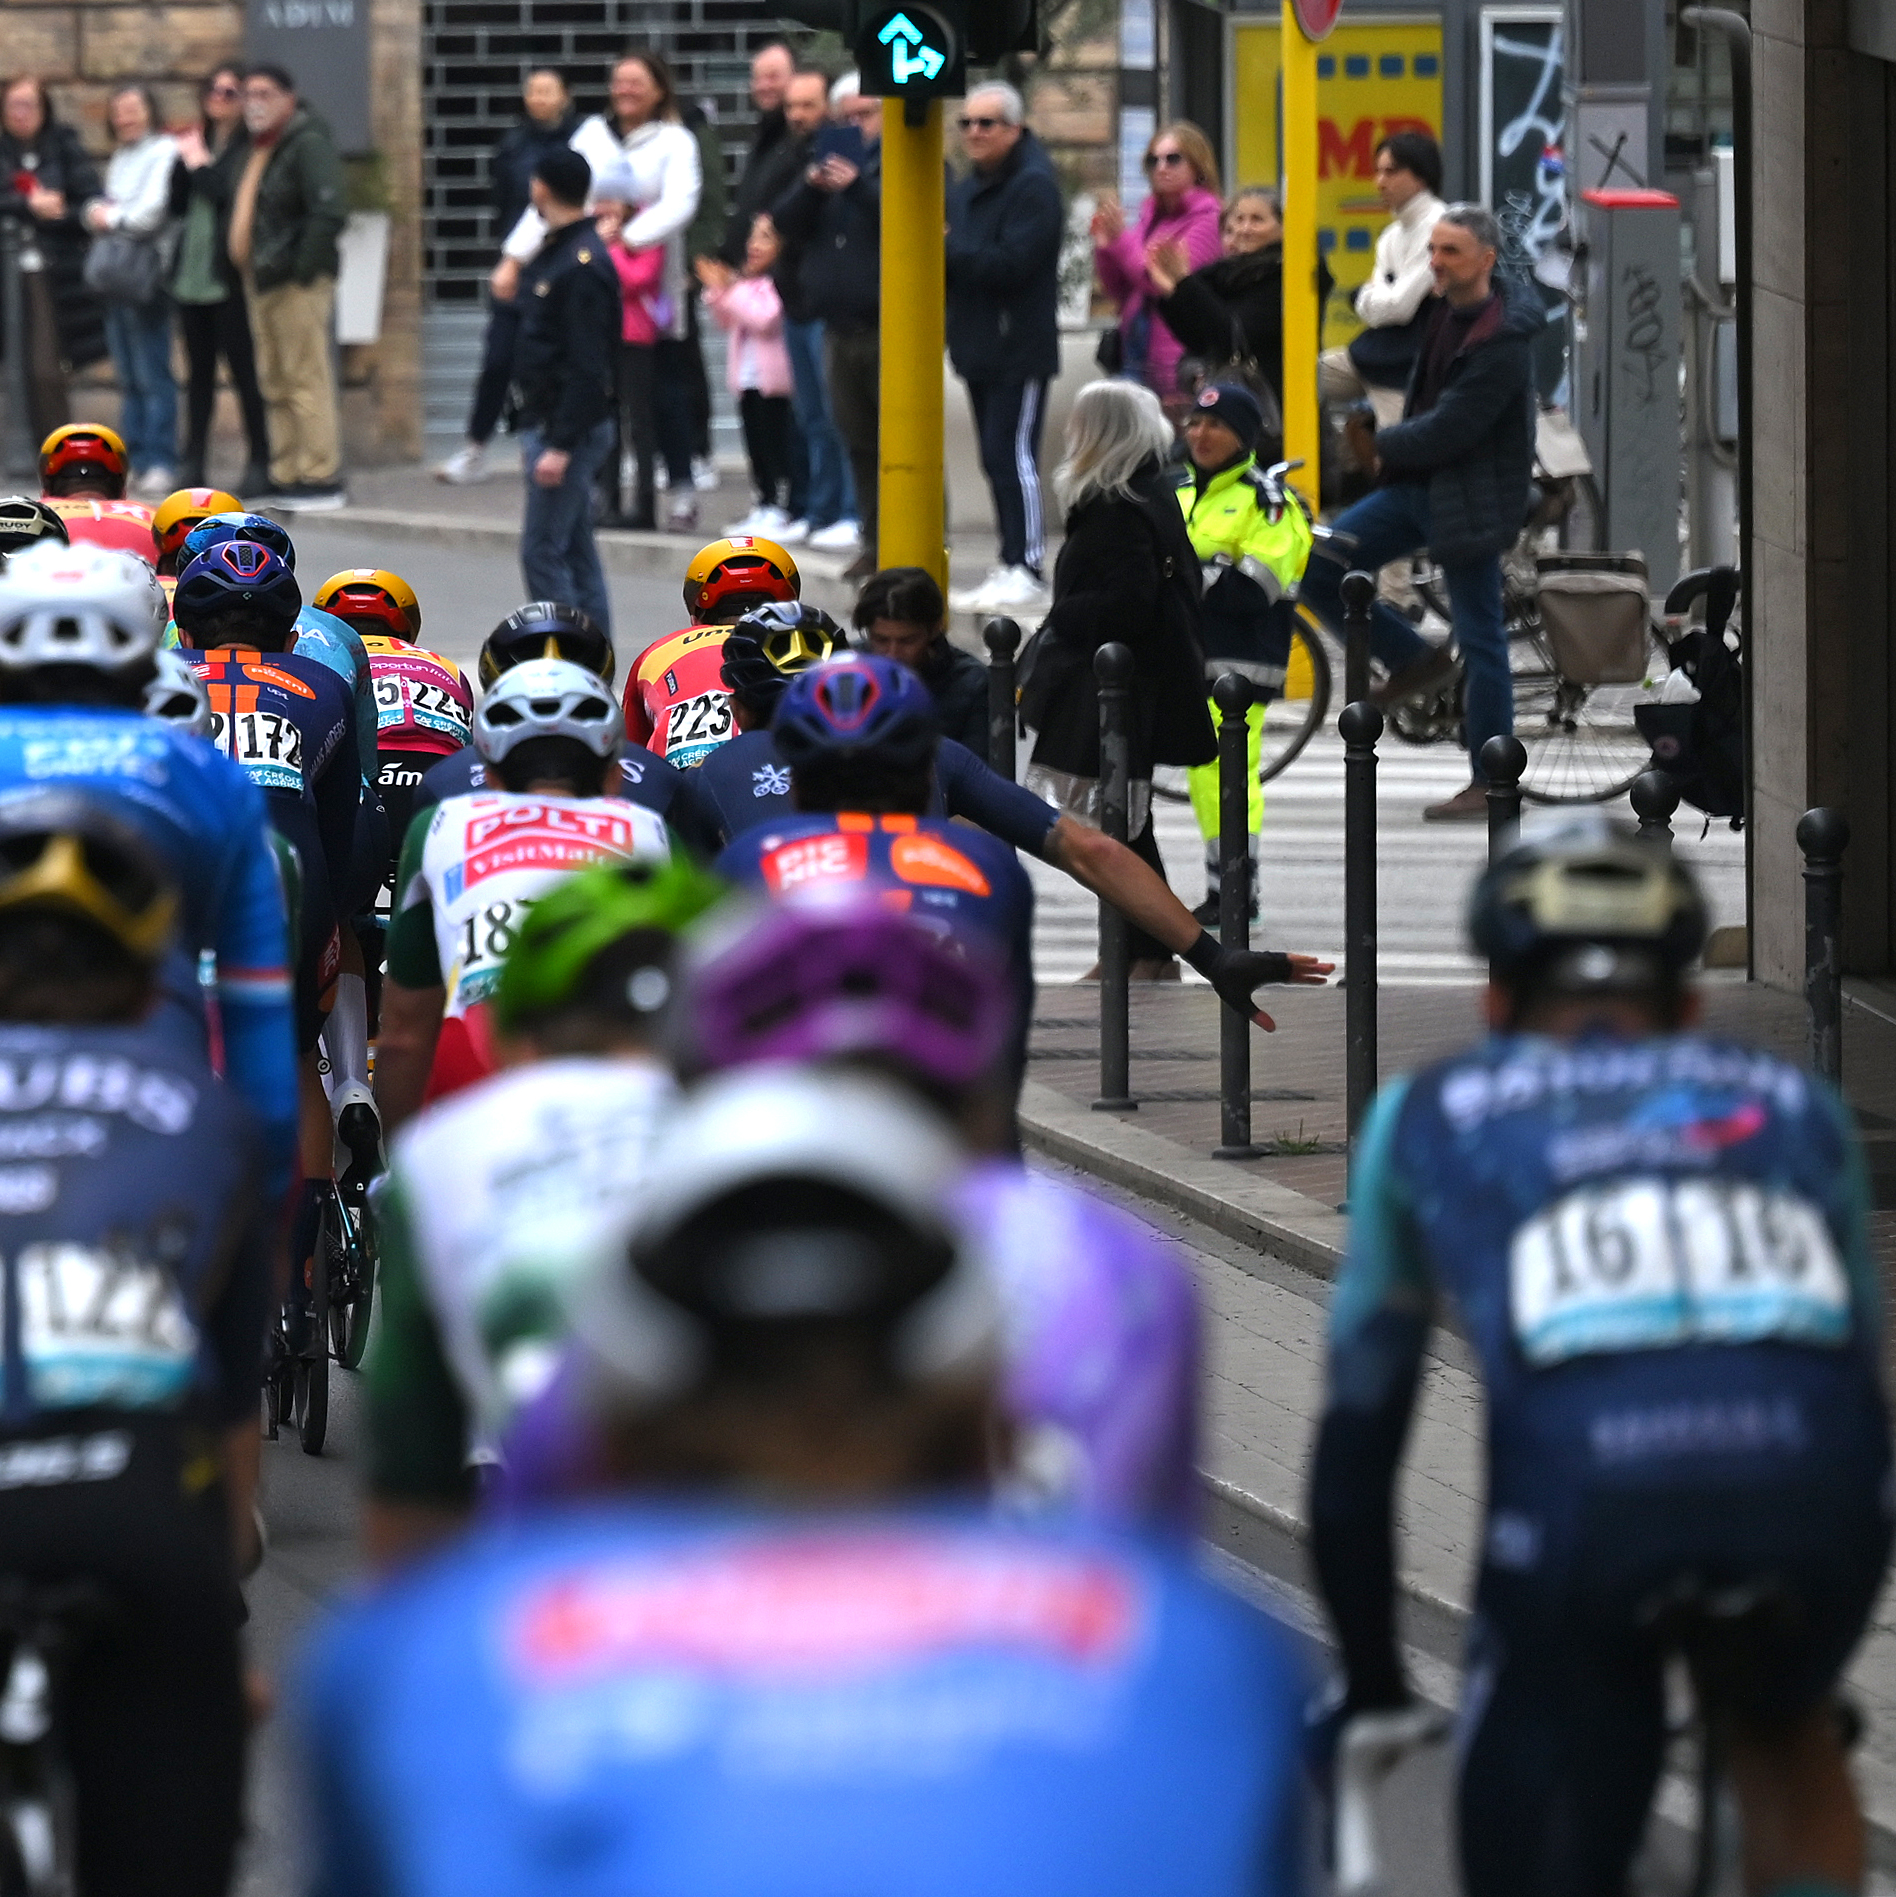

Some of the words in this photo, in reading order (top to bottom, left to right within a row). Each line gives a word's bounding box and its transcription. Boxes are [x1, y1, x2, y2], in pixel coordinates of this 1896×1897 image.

[241, 713, 303, 769] 172
[668, 693, 733, 749] 223
[470, 806, 632, 851] POLTI
[463, 899, 532, 966] 18
